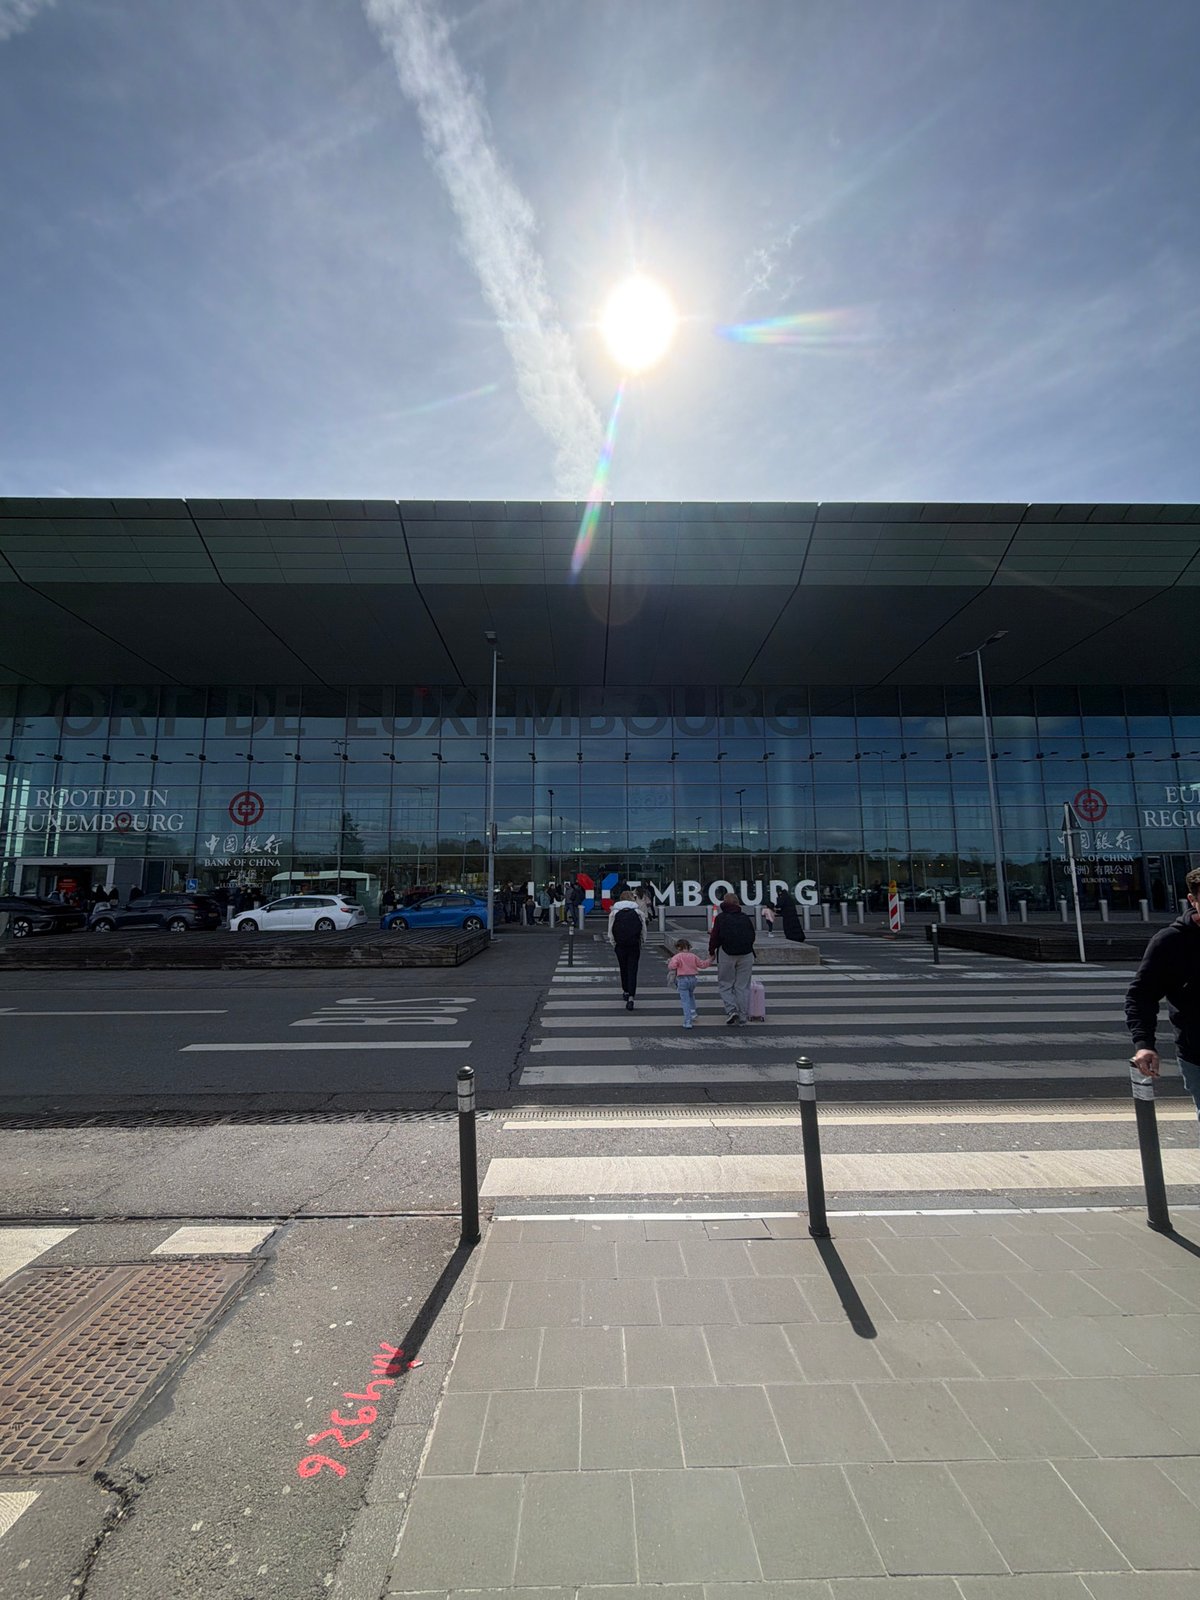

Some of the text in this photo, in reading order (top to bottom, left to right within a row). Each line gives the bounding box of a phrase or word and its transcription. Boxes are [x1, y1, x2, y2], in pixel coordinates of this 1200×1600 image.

[0, 686, 810, 738] PORT DE LUXEMBOURG
[35, 789, 169, 807] ROOTED IN
[1164, 786, 1200, 803] EU
[204, 858, 281, 867] BANK OF CHINA
[1060, 854, 1135, 862] BK OF CHINA
[288, 997, 477, 1027] BUS
